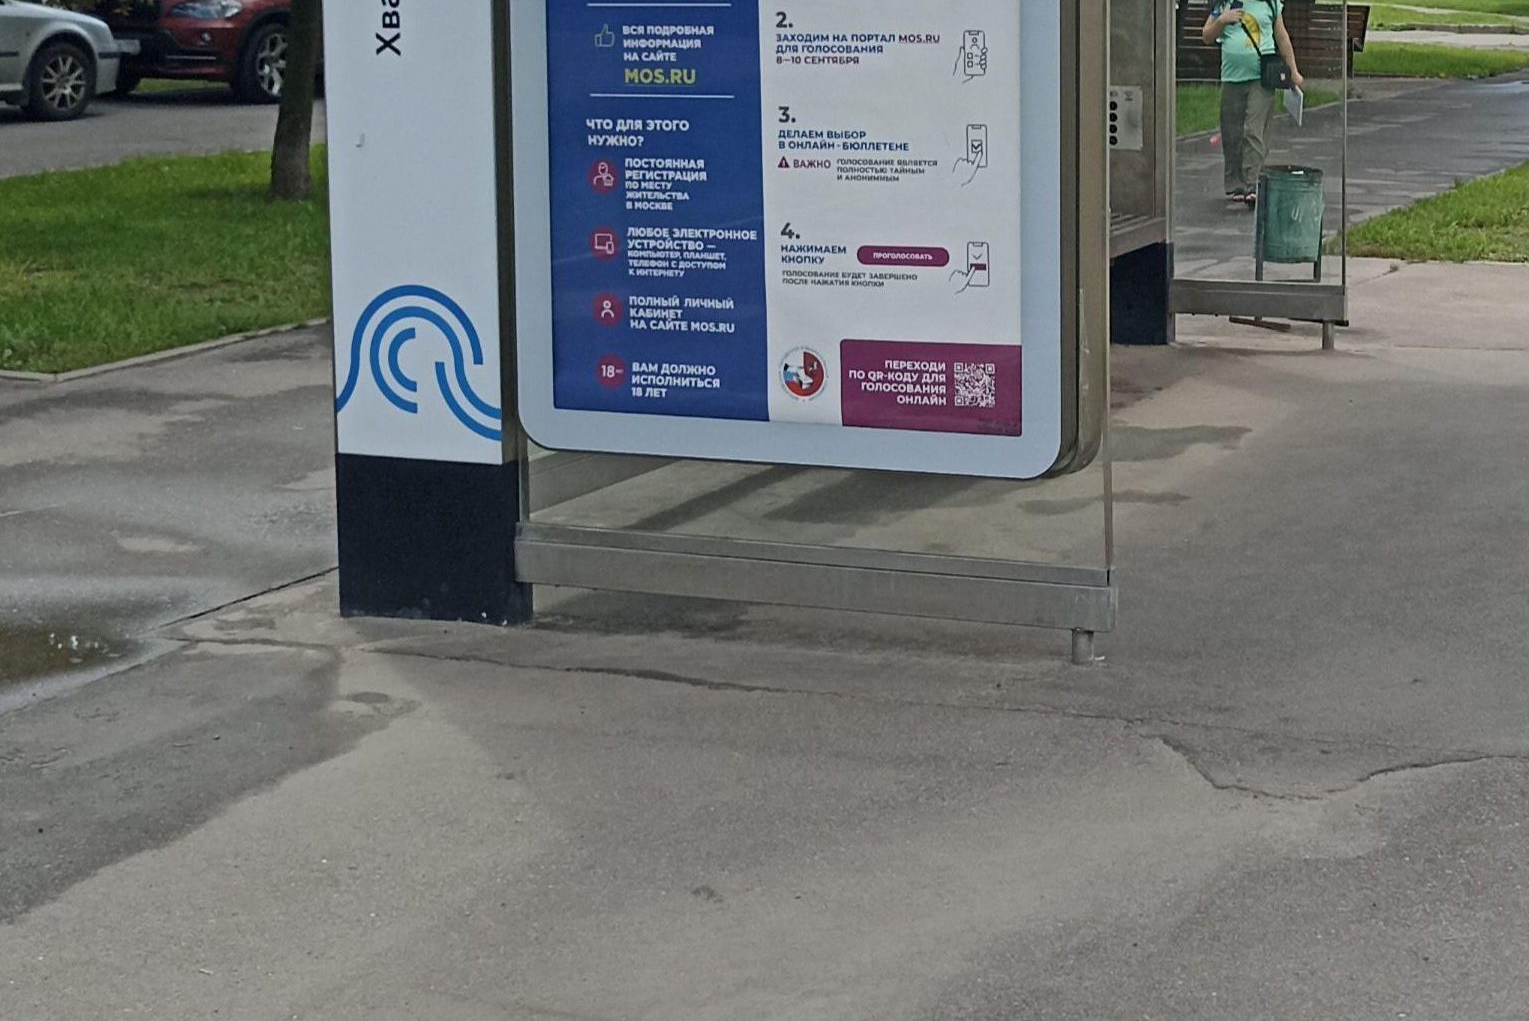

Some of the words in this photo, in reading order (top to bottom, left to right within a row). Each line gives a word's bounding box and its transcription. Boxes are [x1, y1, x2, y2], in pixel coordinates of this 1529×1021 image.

[775, 11, 794, 28] 2.
[622, 25, 645, 35] ВСЯ
[646, 25, 715, 36] ПОДРОБНАЯ
[623, 38, 702, 49] ИНФОРМАЦИЯ
[776, 34, 829, 44] ЗАХОДИМ
[832, 34, 848, 43] НА
[851, 34, 895, 43] ПОРТАЛ
[898, 34, 940, 44] MOS.RU
[623, 52, 639, 61] НА
[641, 50, 677, 61] САЙТЕ
[775, 45, 798, 55] ДЛЯ
[801, 45, 884, 54] ГОЛОСОВАНИЯ
[804, 56, 859, 65] СЕНТЯБРЯ
[624, 68, 696, 84] MOS.RU
[778, 105, 796, 123] 3.
[586, 118, 613, 130] ЧТО
[615, 119, 643, 132] ДЛЯ
[646, 119, 690, 131] ЭТОГО
[778, 129, 824, 140] ДЕЛАЕМ
[826, 130, 867, 139] ВЫБОР
[587, 135, 644, 147] НУЖНО?
[778, 140, 785, 149] В
[624, 158, 705, 169] ПОСТОЯННАЯ
[793, 159, 831, 169] ВАЖНО
[836, 158, 895, 166] ГОЛОСОВАНИЕ
[625, 170, 707, 182] РЕГИСТРАЦИЯ
[625, 181, 639, 189] ПО
[640, 182, 672, 190] МЕСТУ
[626, 191, 690, 200] ЖИТЕЛЬСТВА
[634, 202, 673, 210] МОСКВЕ
[627, 227, 670, 238] ЛЮБОЕ
[672, 228, 758, 240] ЭЛЕКТРОННОЕ
[780, 222, 801, 239] 4.
[627, 238, 704, 250] УСТРОЙСТВО
[780, 244, 847, 255] НАЖИМАЕМ
[781, 255, 825, 265] КНОПКУ
[873, 251, 933, 261] ПРОГОЛОСОВАТЬ
[678, 261, 726, 270] ДОСТУПОМ
[782, 270, 839, 278] ГОЛОСОВАНИЕ
[841, 271, 866, 279] БУДЕТ
[629, 295, 679, 307] ПОЛНЫЙ
[684, 297, 734, 309] ЛИЧНЫЙ
[630, 308, 682, 318] КАБИНЕТ
[630, 320, 647, 329] НА
[649, 318, 688, 330] САЙТЕ
[690, 322, 735, 333] MOS.RU
[632, 362, 659, 372] ВАМ
[660, 363, 716, 375] ДОЛЖНО
[884, 360, 946, 371] ПЕРЕХОДИ
[631, 375, 720, 388] ИСПОЛНИТЬСЯ
[848, 370, 864, 379] ПО
[867, 371, 919, 383] QR-КОДУ
[921, 372, 946, 384] ДЛЯ
[631, 387, 642, 397] 18
[644, 388, 667, 398] ЛЕТ
[861, 382, 947, 394] ГОЛОСОВАНИЯ
[896, 393, 947, 406] ОНЛАЙН
